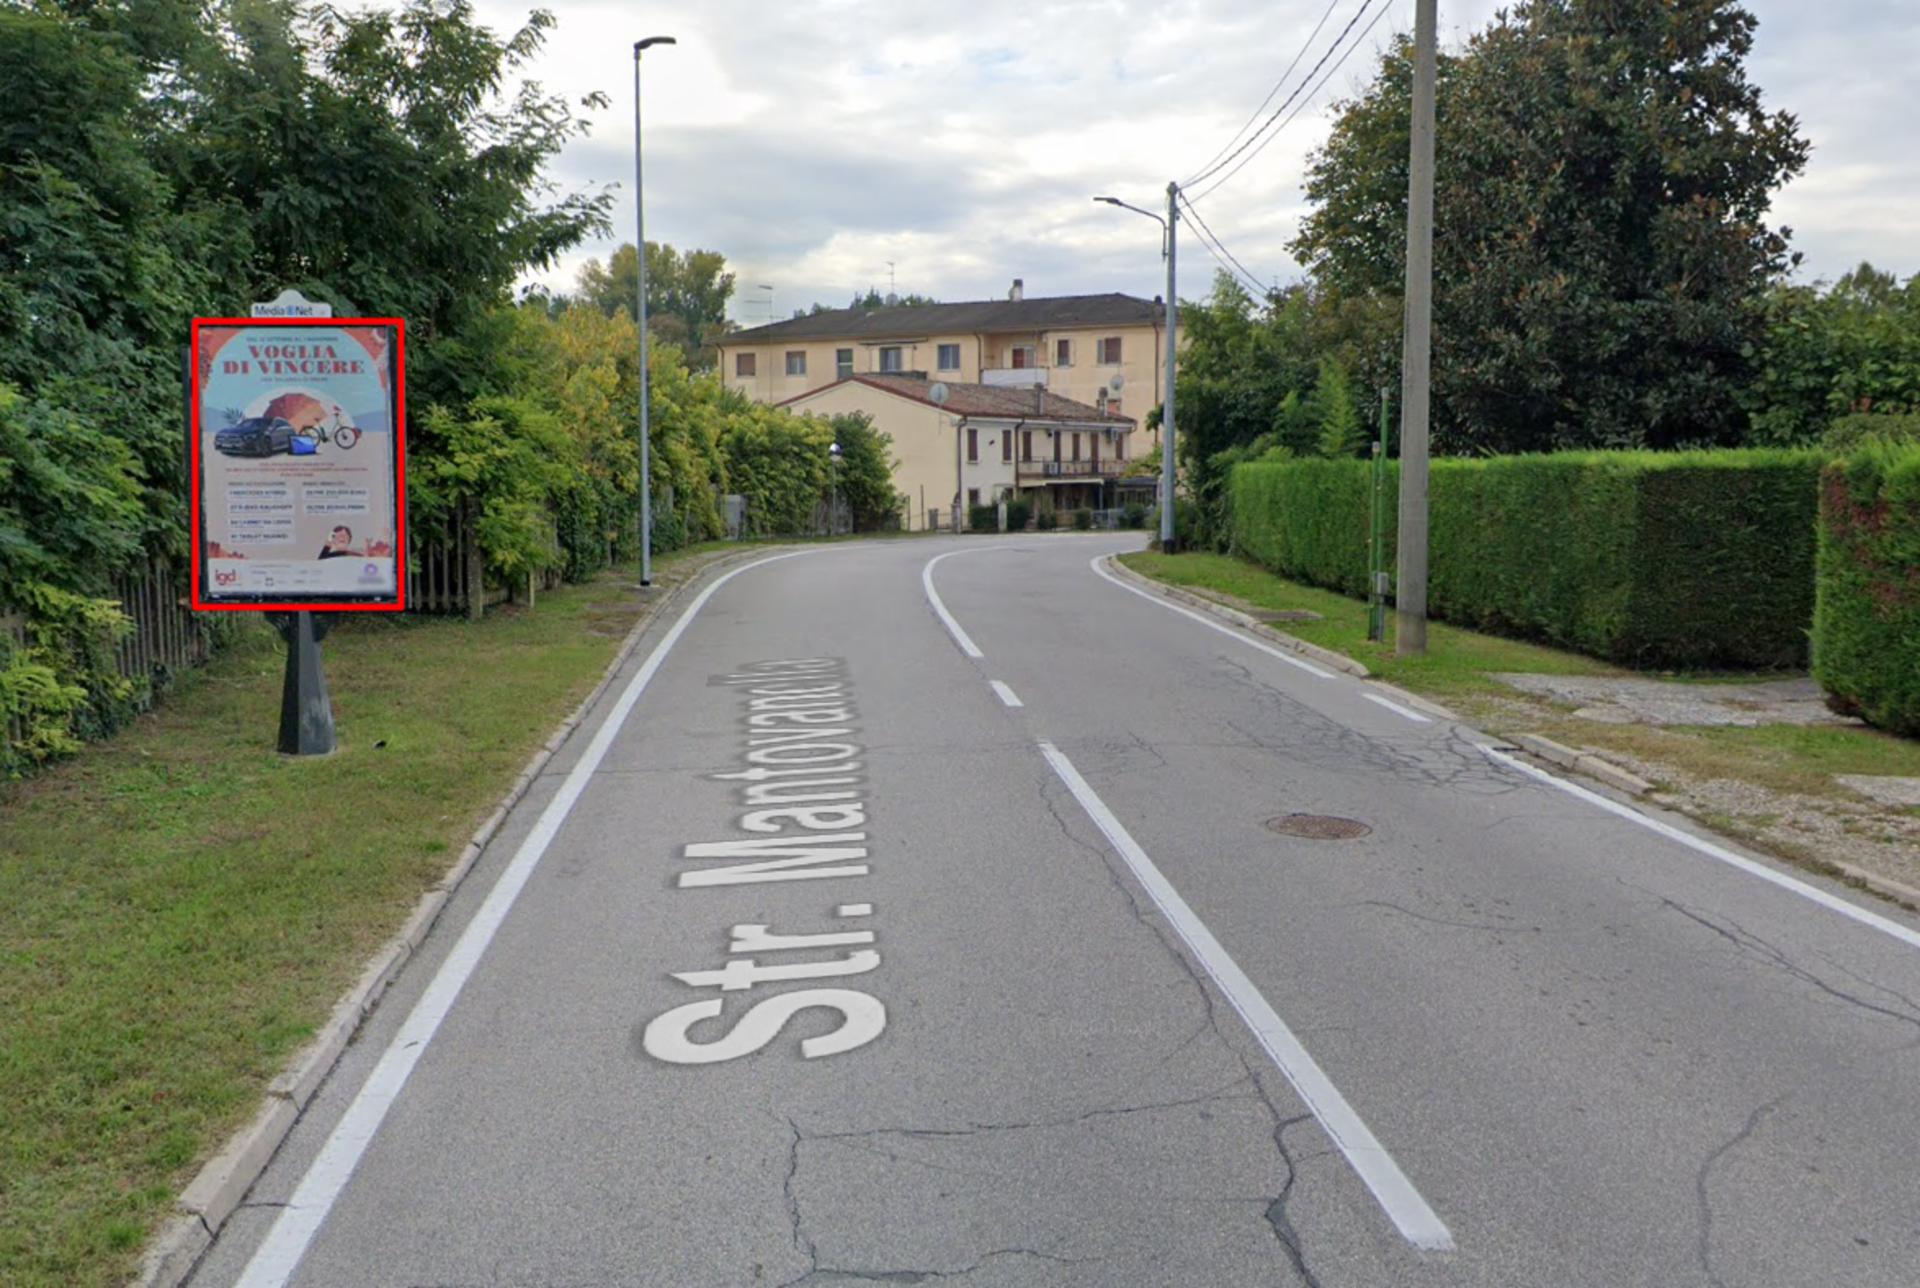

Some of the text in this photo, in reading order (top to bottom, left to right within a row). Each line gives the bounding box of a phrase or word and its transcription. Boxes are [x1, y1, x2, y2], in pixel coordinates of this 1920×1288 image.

[248, 345, 338, 359] VOGLIA
[223, 361, 365, 375] DI VINCERE
